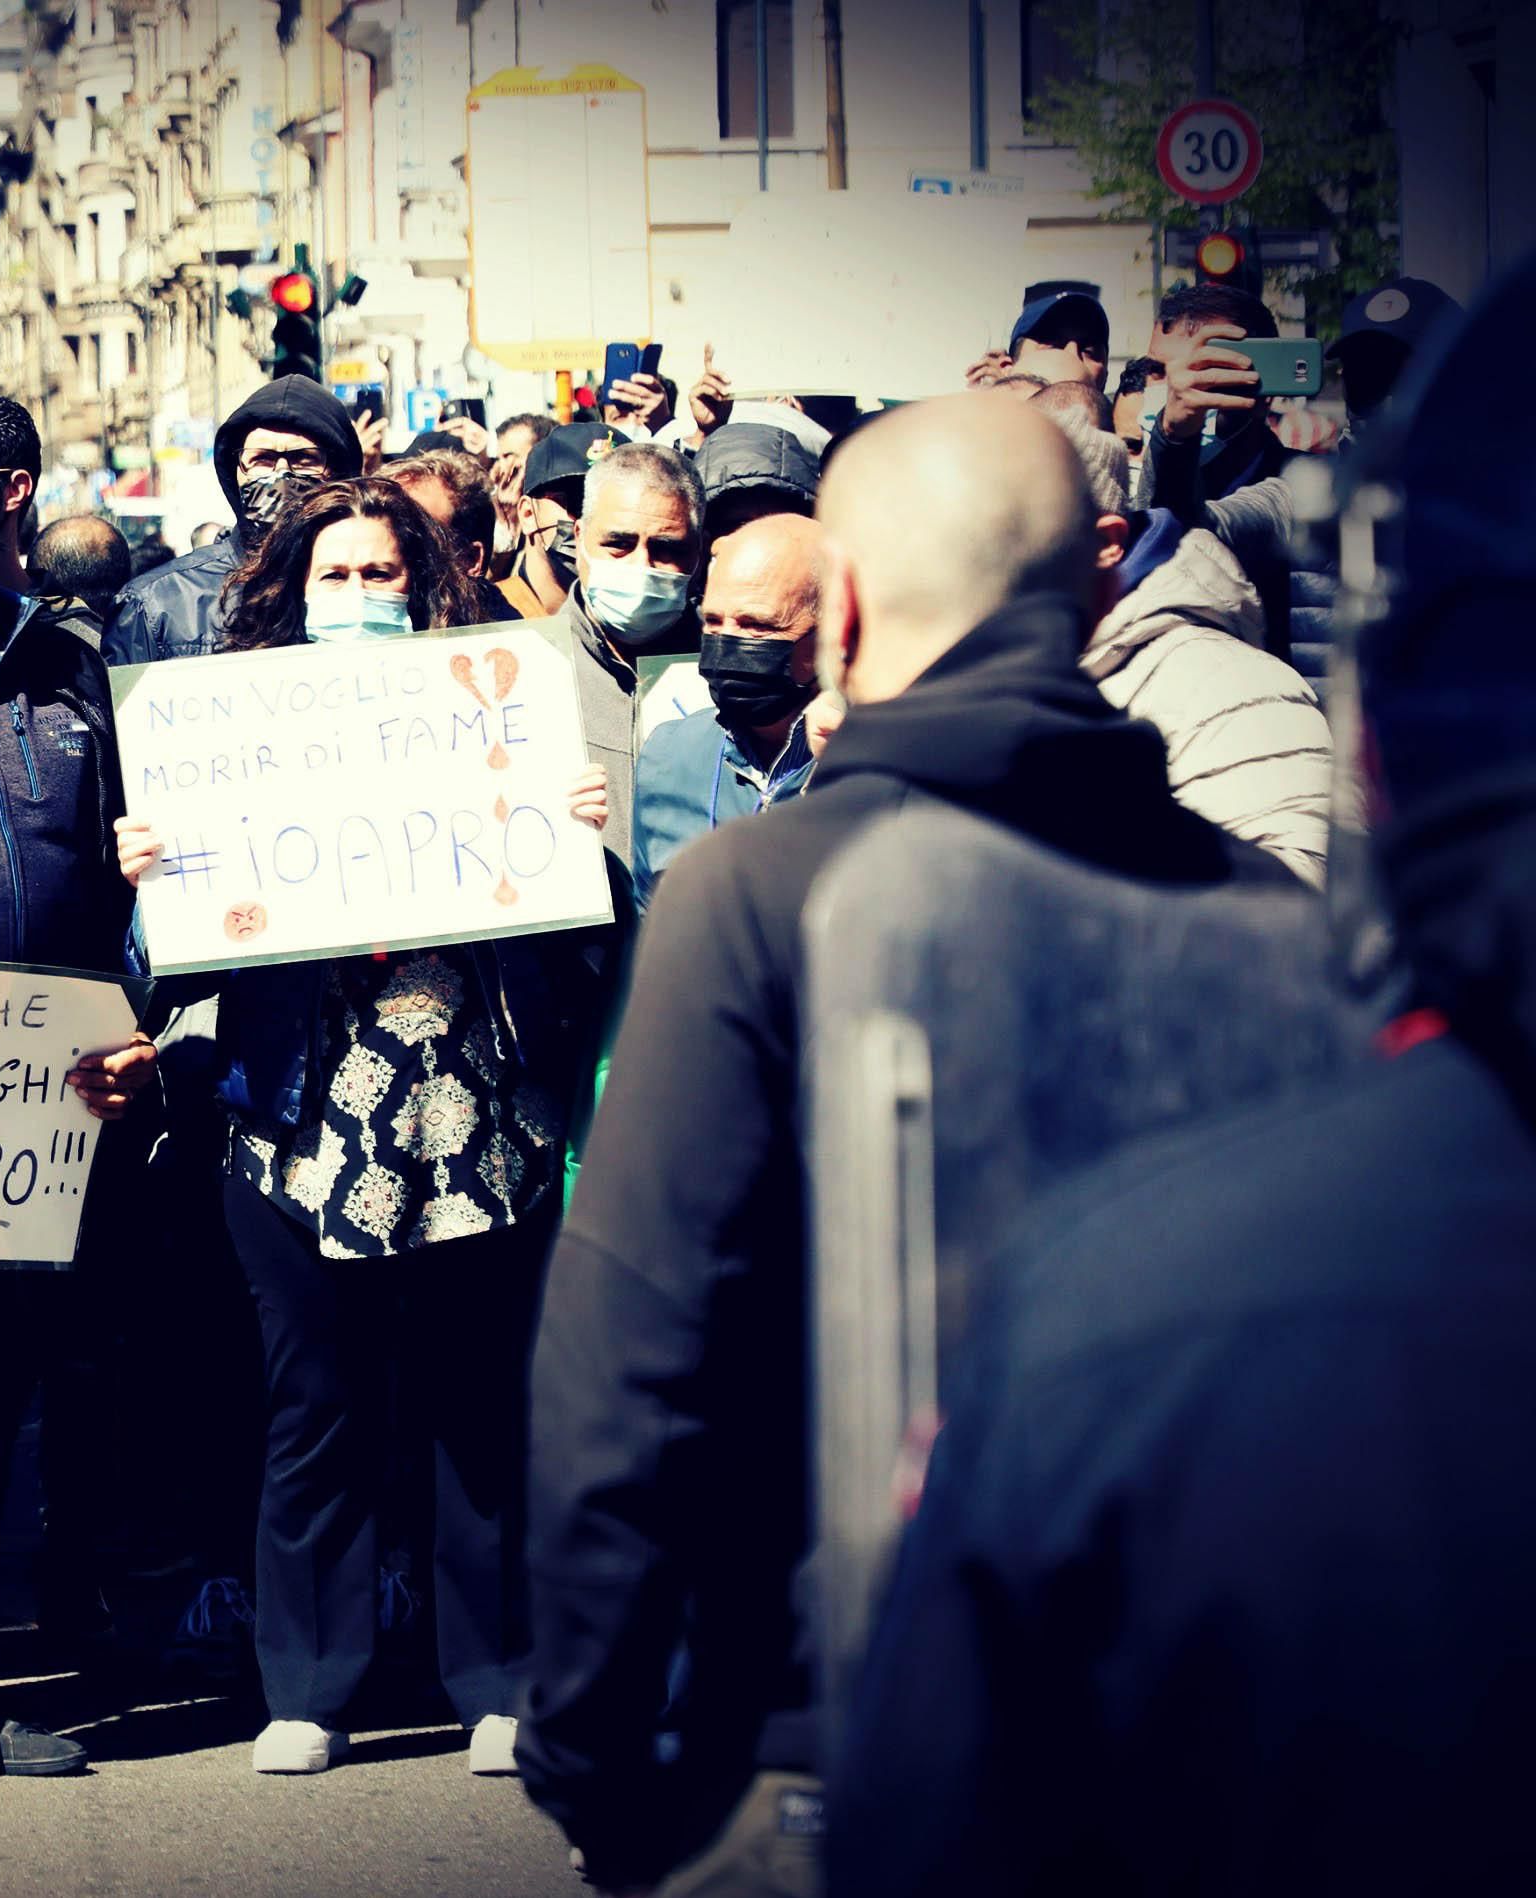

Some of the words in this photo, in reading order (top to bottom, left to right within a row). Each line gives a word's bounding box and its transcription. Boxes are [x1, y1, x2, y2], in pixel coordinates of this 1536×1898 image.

[1184, 129, 1240, 175] 30
[149, 698, 232, 730] NON
[377, 703, 528, 763] FAME
